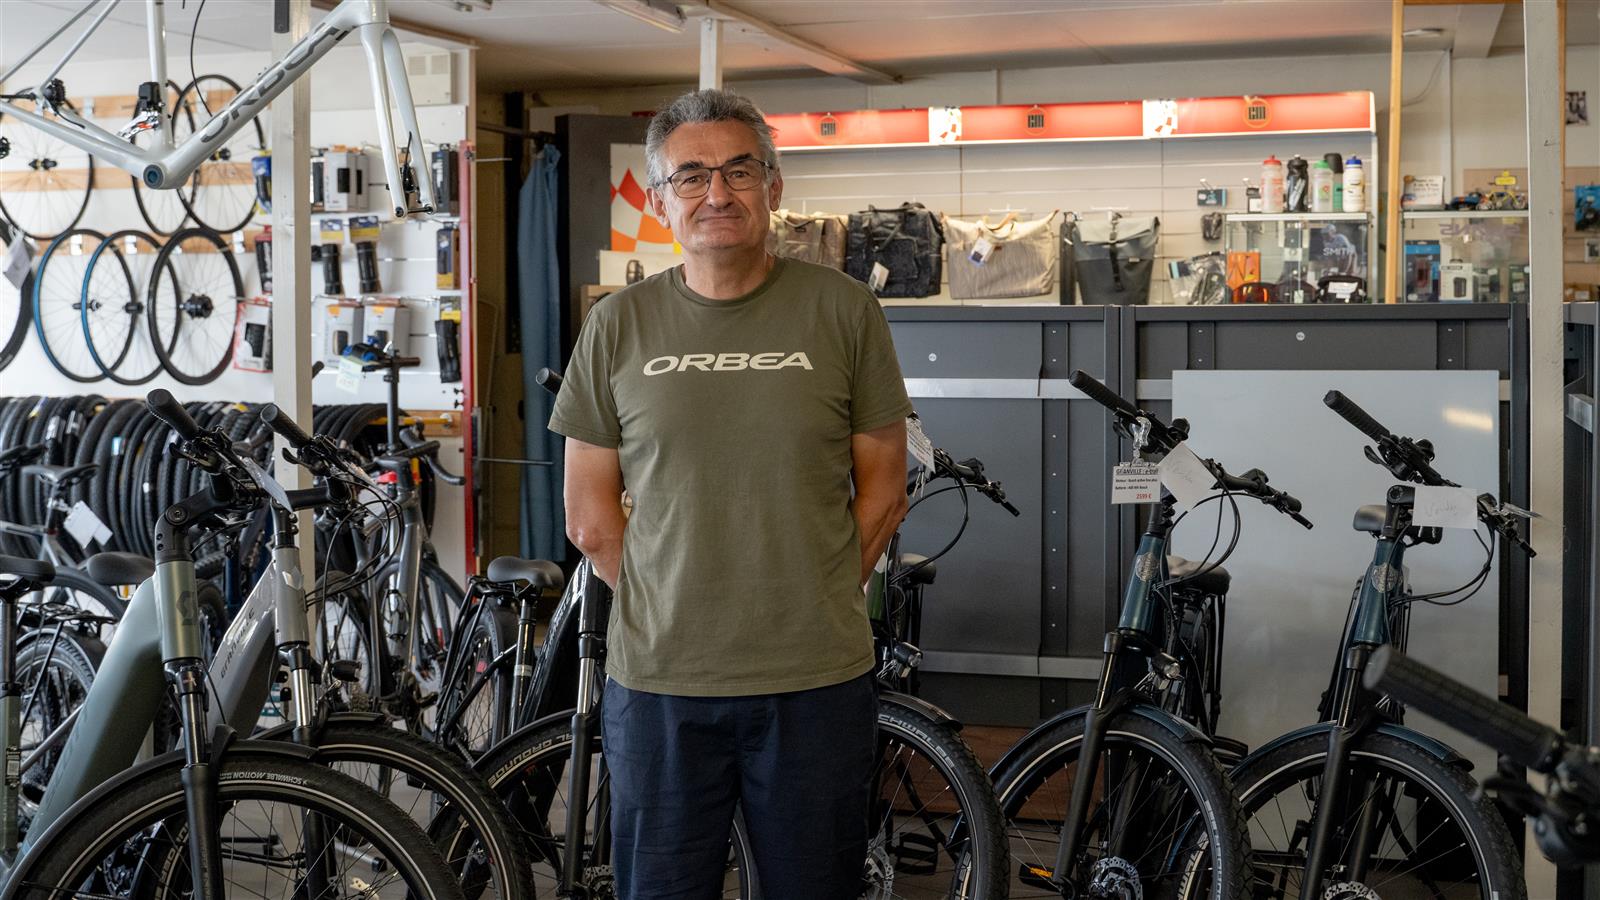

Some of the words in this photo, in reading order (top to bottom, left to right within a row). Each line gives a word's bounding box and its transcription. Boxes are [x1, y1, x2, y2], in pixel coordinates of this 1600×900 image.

[1322, 247, 1353, 257] SMITH
[643, 352, 814, 376] ORBEA
[877, 713, 955, 768] CHWALBE
[487, 739, 552, 787] GROUNDE
[232, 771, 267, 780] MOTION
[265, 772, 303, 785] SCHWALBE
